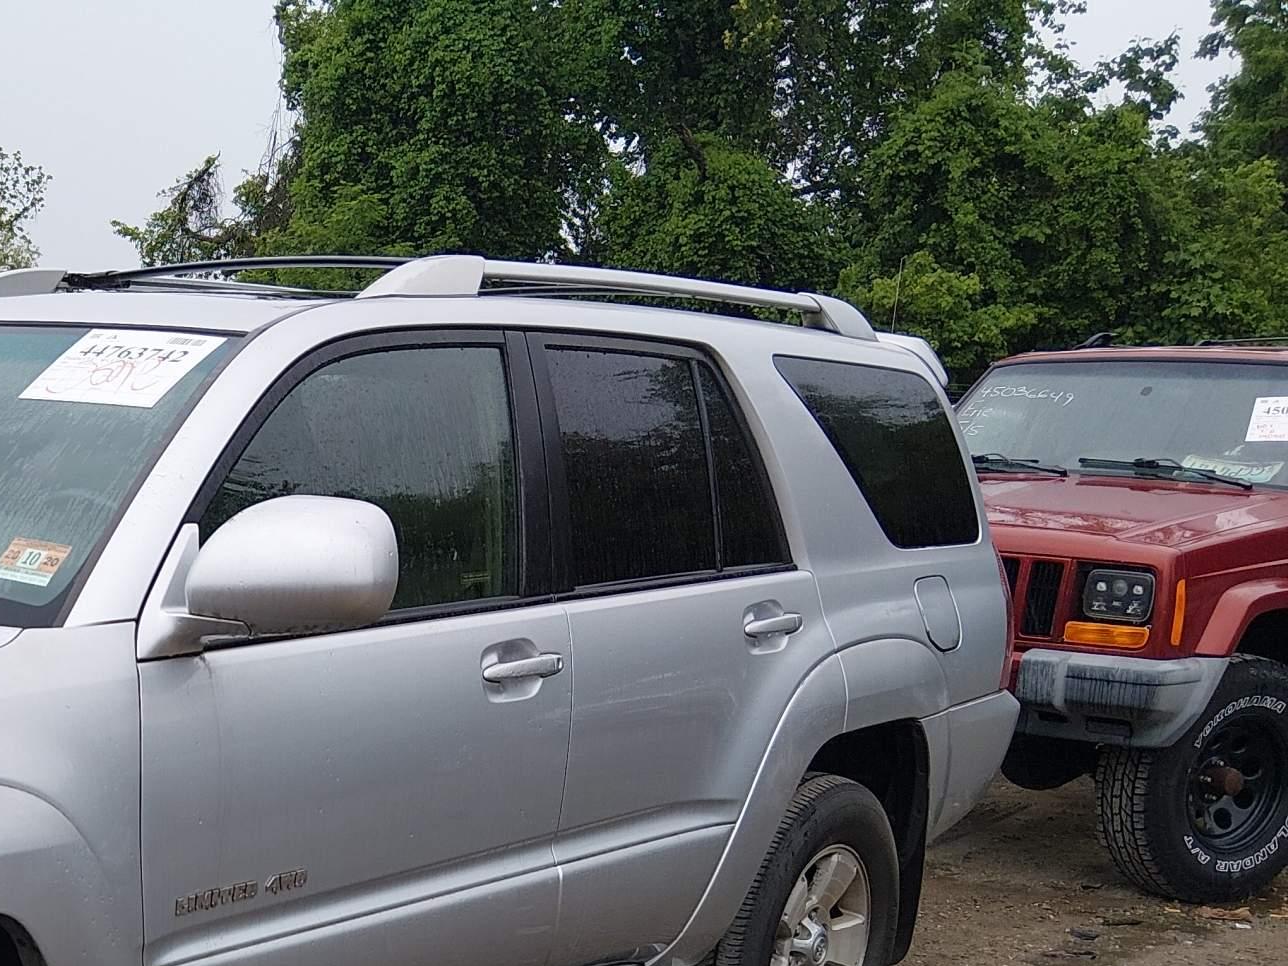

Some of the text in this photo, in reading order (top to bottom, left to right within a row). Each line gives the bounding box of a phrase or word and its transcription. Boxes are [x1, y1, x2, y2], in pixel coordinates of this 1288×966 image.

[79, 344, 189, 363] 44763742
[981, 386, 1074, 406] 45036649
[21, 551, 42, 566] 10
[1194, 695, 1287, 749] YOKOHAMA
[1184, 835, 1211, 865] A/T
[174, 868, 308, 917] LIMITED 4WD
